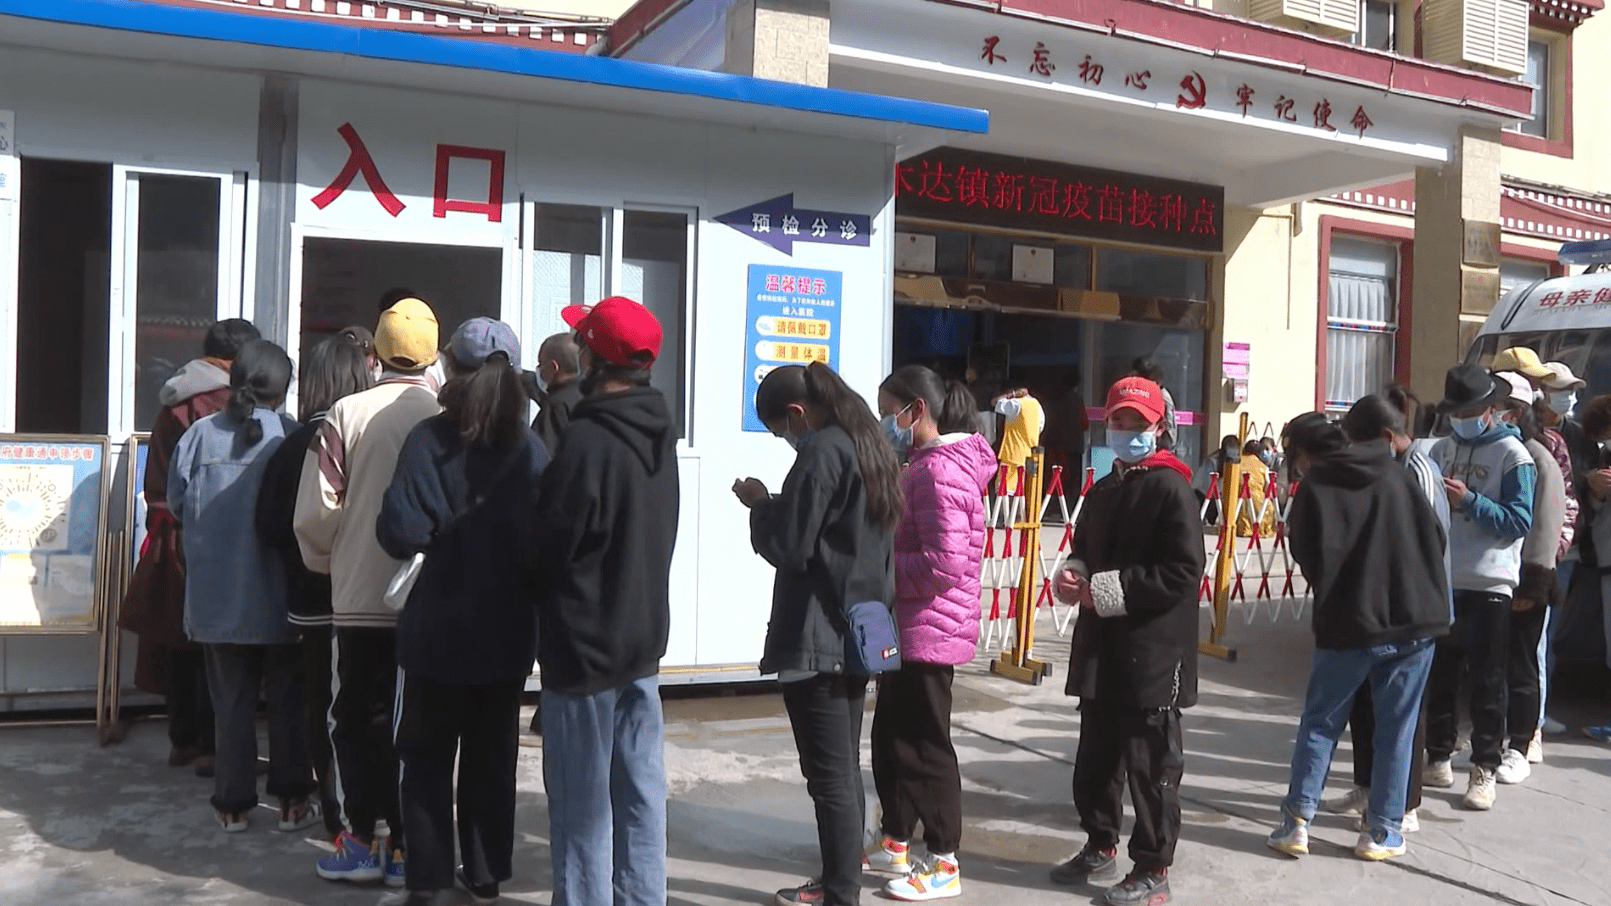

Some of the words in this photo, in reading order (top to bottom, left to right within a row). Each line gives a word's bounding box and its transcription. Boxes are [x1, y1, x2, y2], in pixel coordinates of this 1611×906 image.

[981, 35, 1151, 89] 不忘初心
[1237, 83, 1374, 140] 牢记使命
[310, 121, 506, 223] 入口
[752, 212, 858, 240] 预检分诊
[765, 273, 826, 295] 温馨提示
[777, 319, 827, 337] 请佩戴口罩
[775, 344, 827, 362] 测量体温
